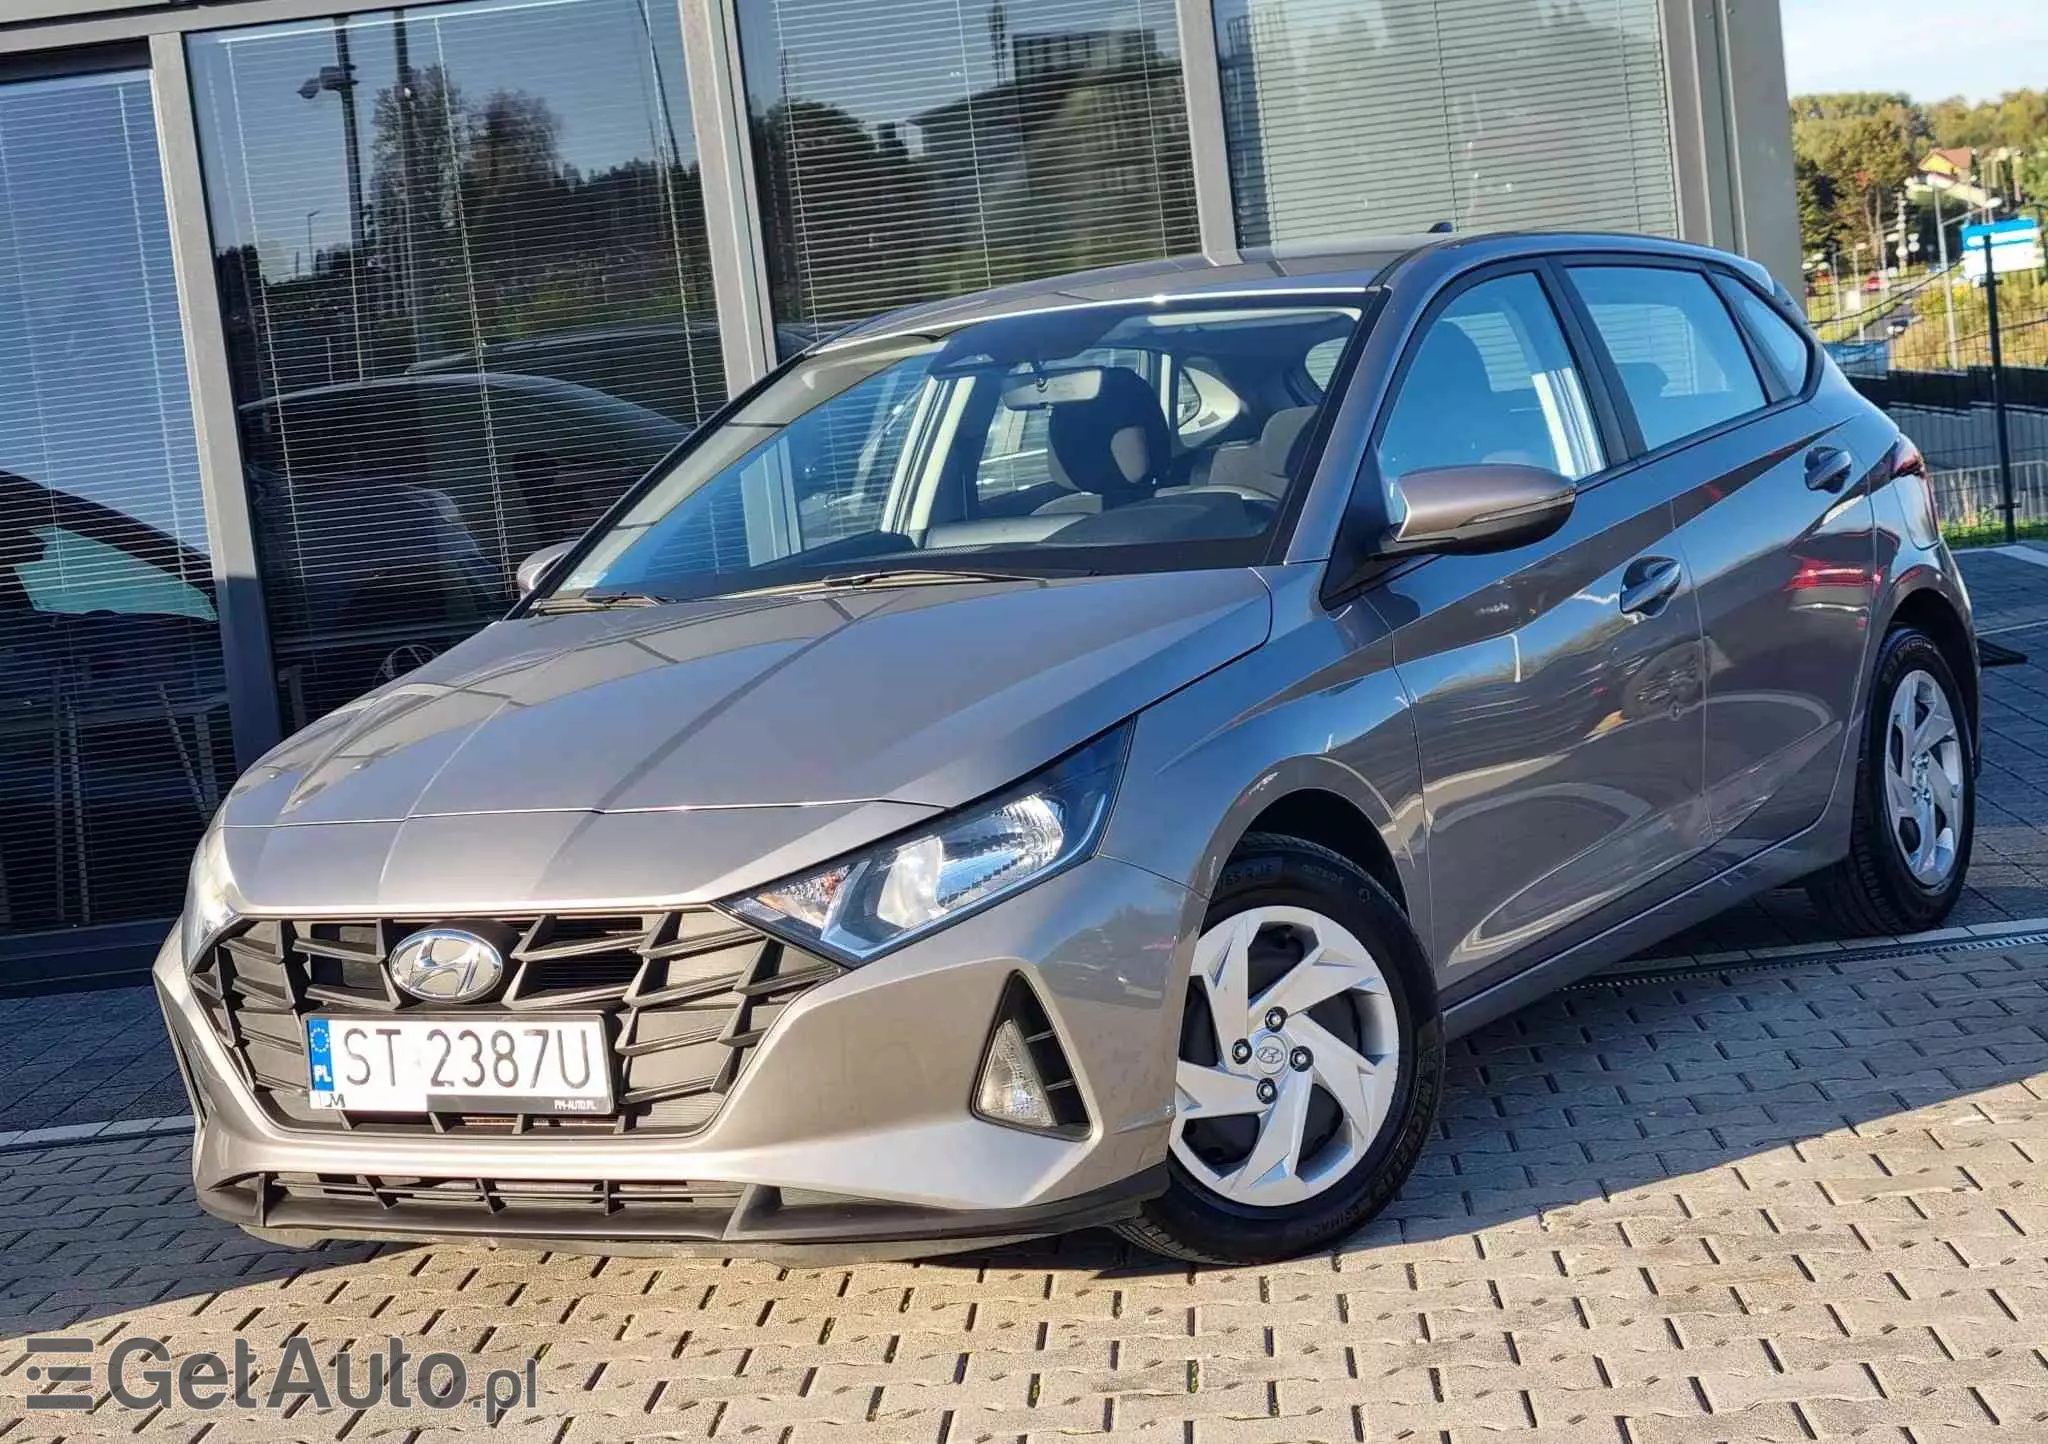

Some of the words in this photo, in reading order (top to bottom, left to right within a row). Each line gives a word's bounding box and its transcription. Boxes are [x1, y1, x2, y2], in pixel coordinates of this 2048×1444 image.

[313, 1065, 333, 1082] PL
[344, 1027, 402, 1087] ST
[426, 1029, 591, 1089] 2387U
